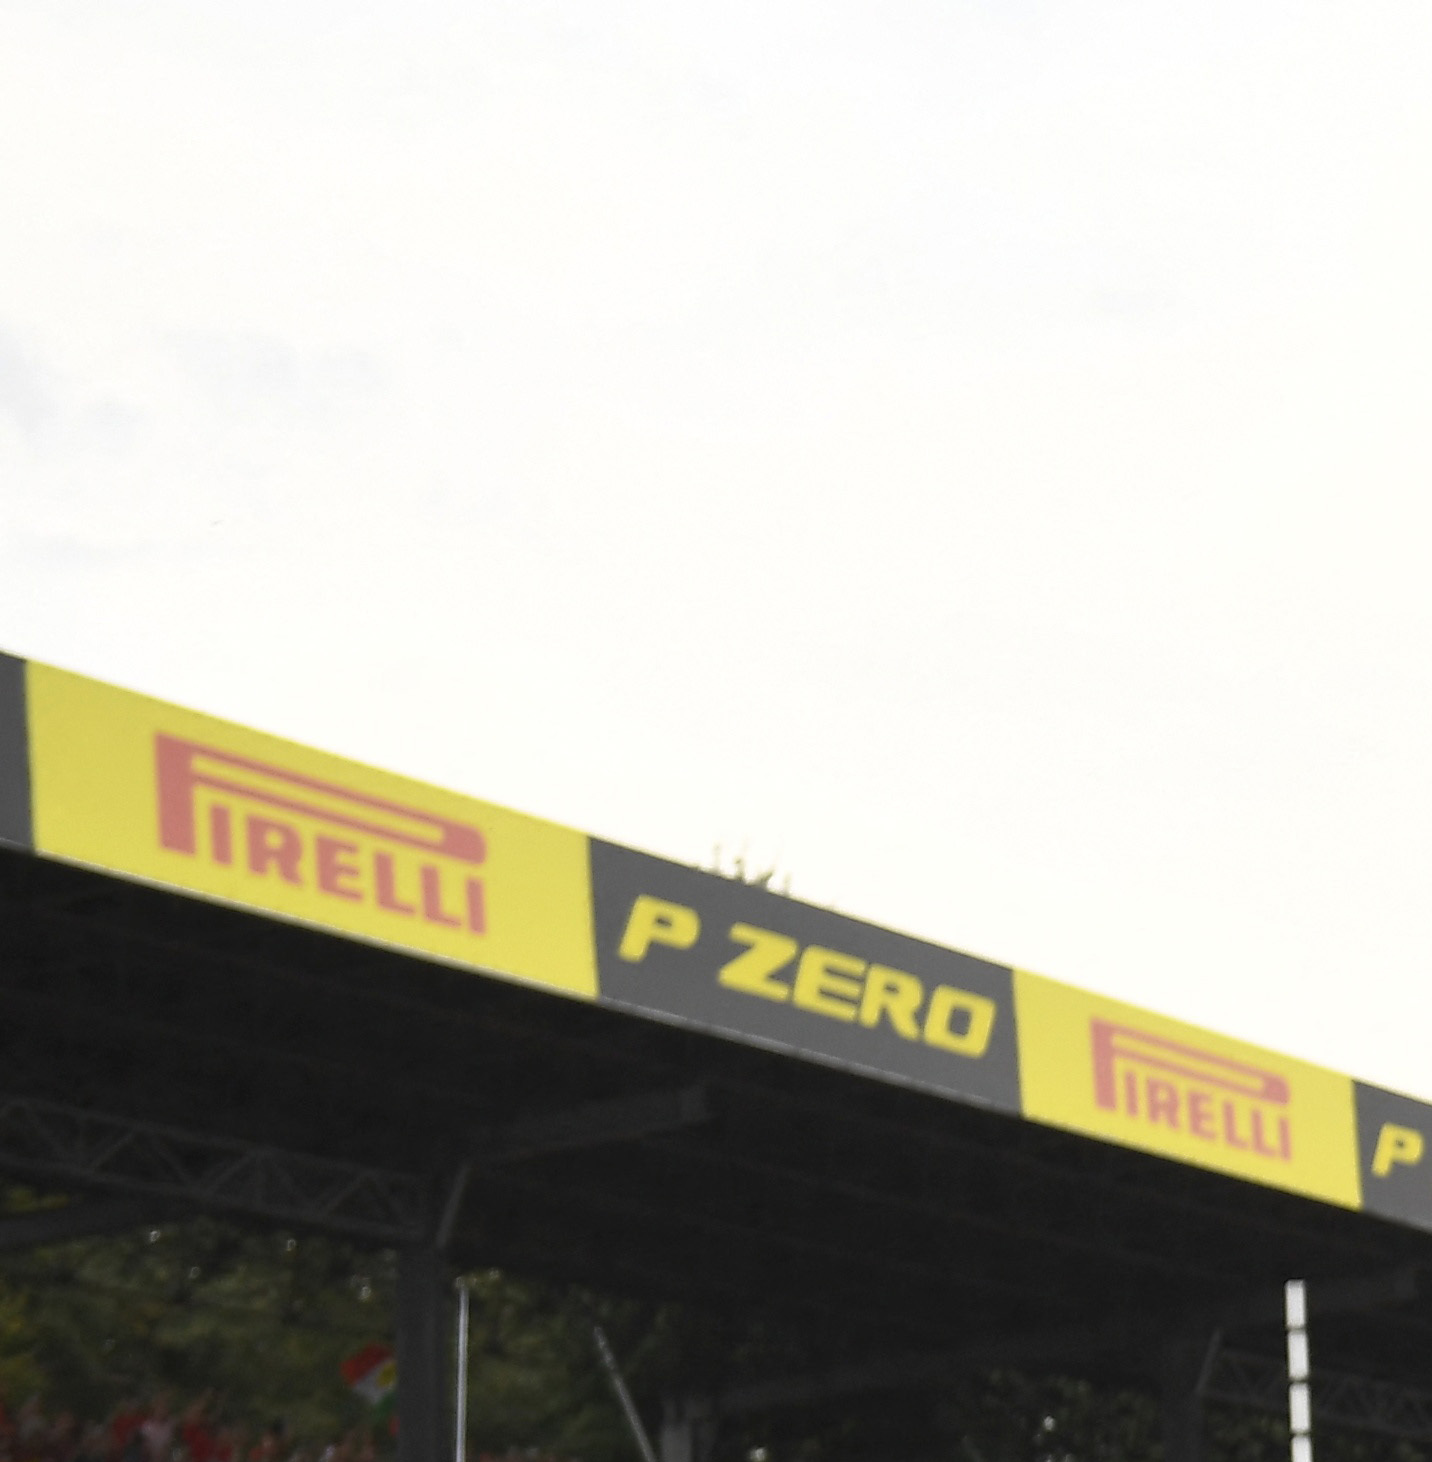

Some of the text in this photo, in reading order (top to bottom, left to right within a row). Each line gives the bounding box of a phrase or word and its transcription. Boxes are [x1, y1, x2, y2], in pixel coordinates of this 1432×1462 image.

[153, 731, 487, 937] PIRELLI
[617, 895, 997, 1059] P ZERO
[1090, 1016, 1292, 1162] PIRELLI
[1371, 1123, 1424, 1177] P
